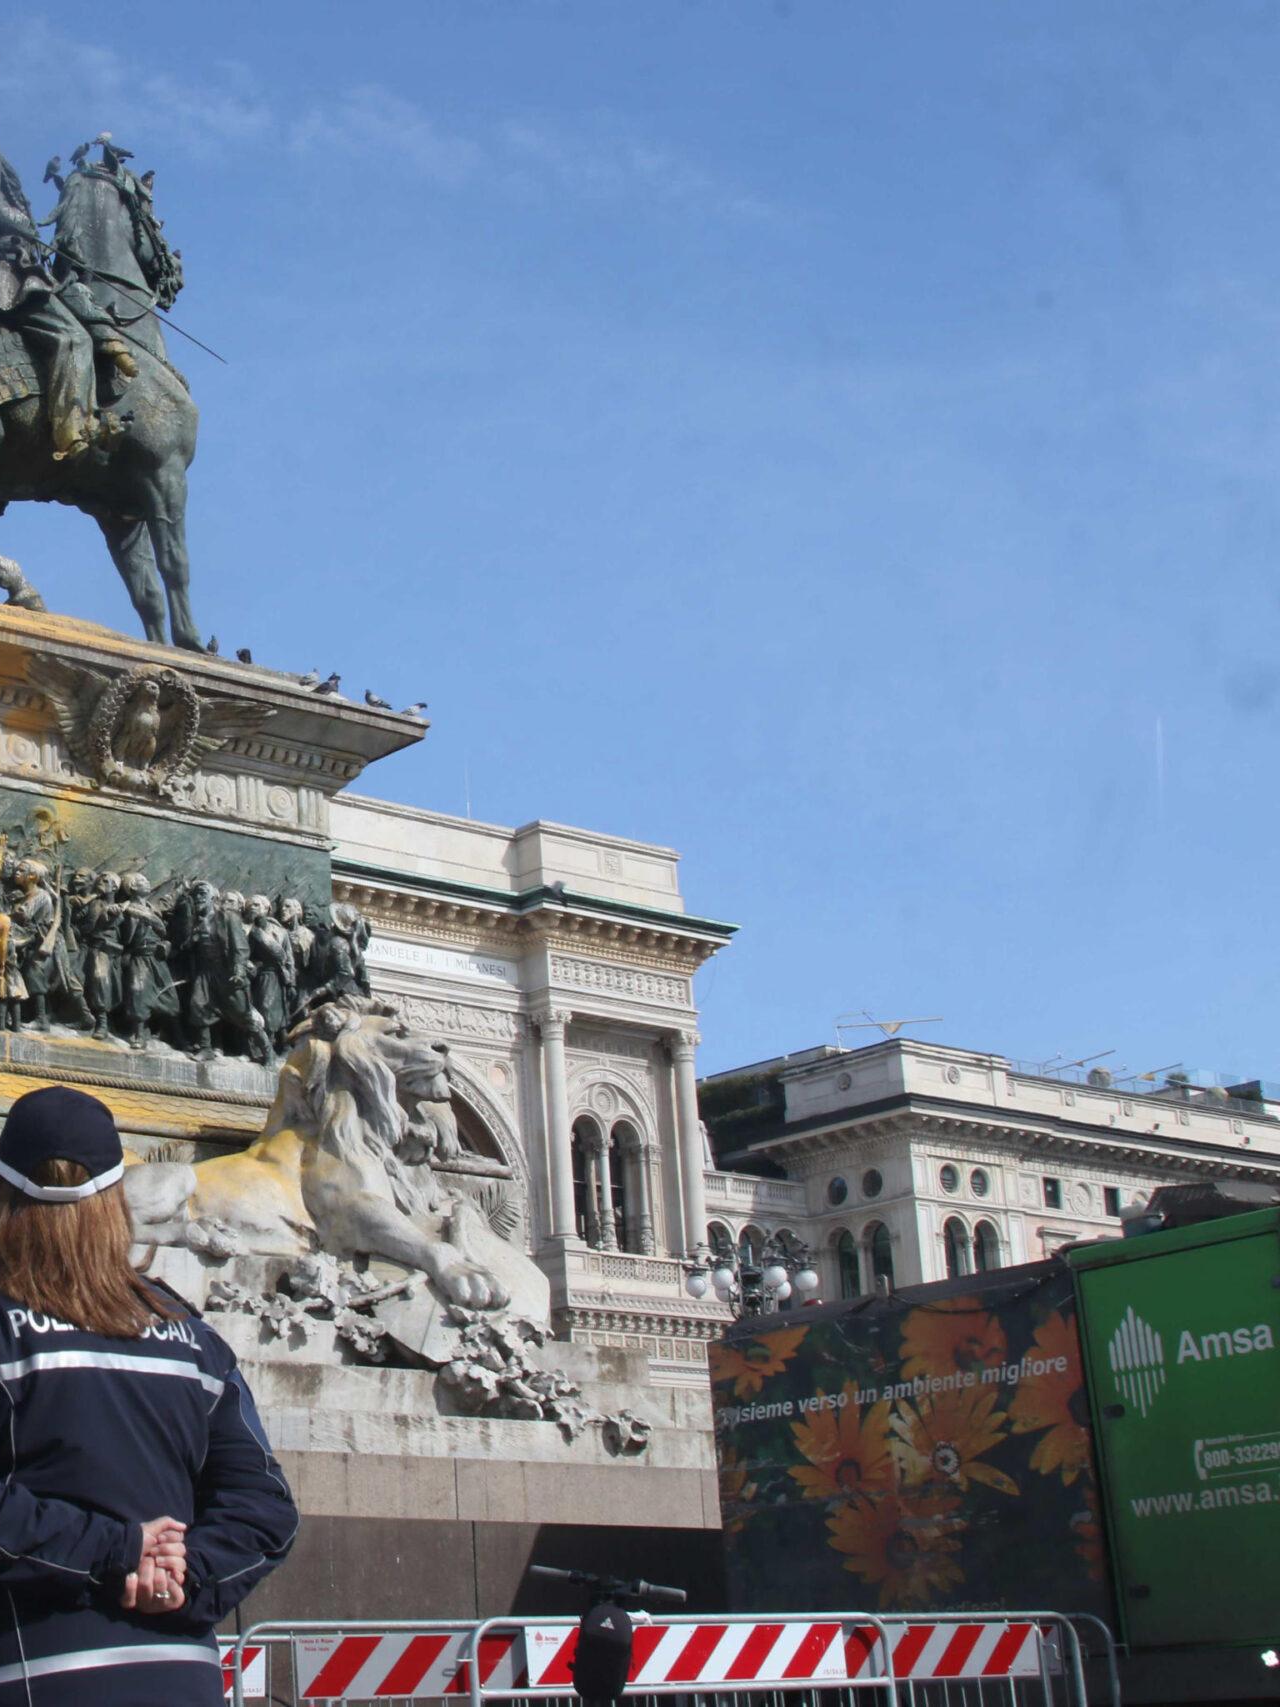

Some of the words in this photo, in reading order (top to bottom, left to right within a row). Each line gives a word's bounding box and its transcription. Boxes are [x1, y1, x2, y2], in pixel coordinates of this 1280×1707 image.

[455, 959, 506, 976] MILANESI
[1176, 1323, 1275, 1365] Amsa
[797, 1388, 849, 1413] verso
[854, 1386, 879, 1405] un
[882, 1369, 977, 1402] ambiente
[980, 1354, 1069, 1386] migliore
[1203, 1440, 1280, 1469] 800-33229
[1130, 1481, 1280, 1519] www.amsa.
